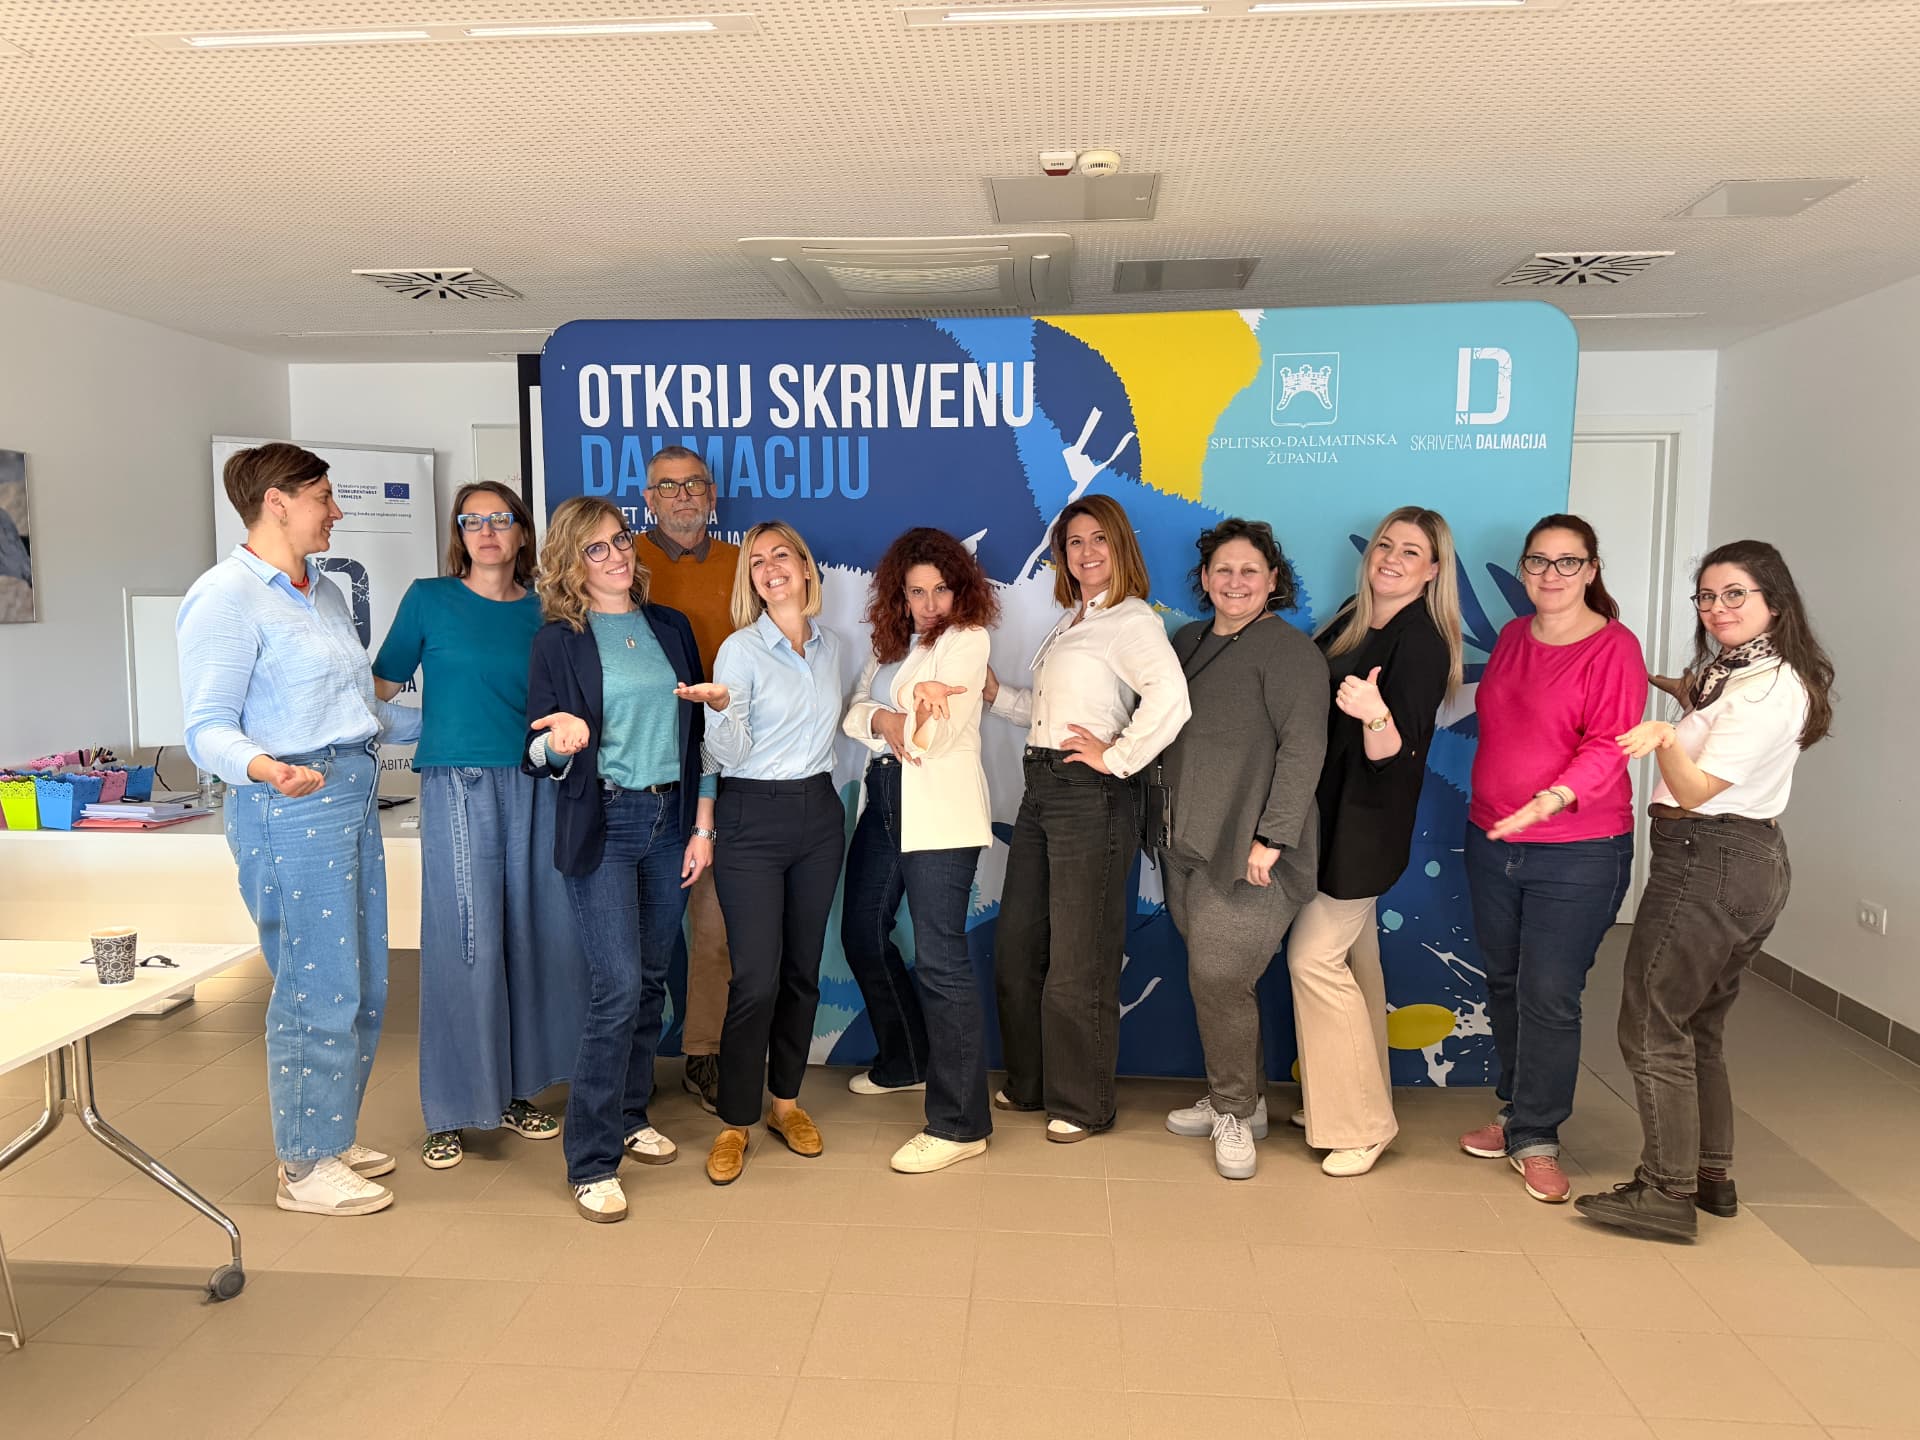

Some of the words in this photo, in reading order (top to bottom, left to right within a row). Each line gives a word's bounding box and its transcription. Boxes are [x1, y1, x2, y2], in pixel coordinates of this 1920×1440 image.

[579, 363, 752, 428] OTKRIJ
[769, 362, 1035, 428] SKRIVENU
[1210, 433, 1398, 449] SPLITSKO-DALMATINSKA
[1410, 434, 1472, 451] SKRIVENA
[1475, 433, 1547, 449] DALMACIJA
[581, 435, 869, 498] DAMACIJU
[1266, 450, 1338, 465] ŽUPANIJA
